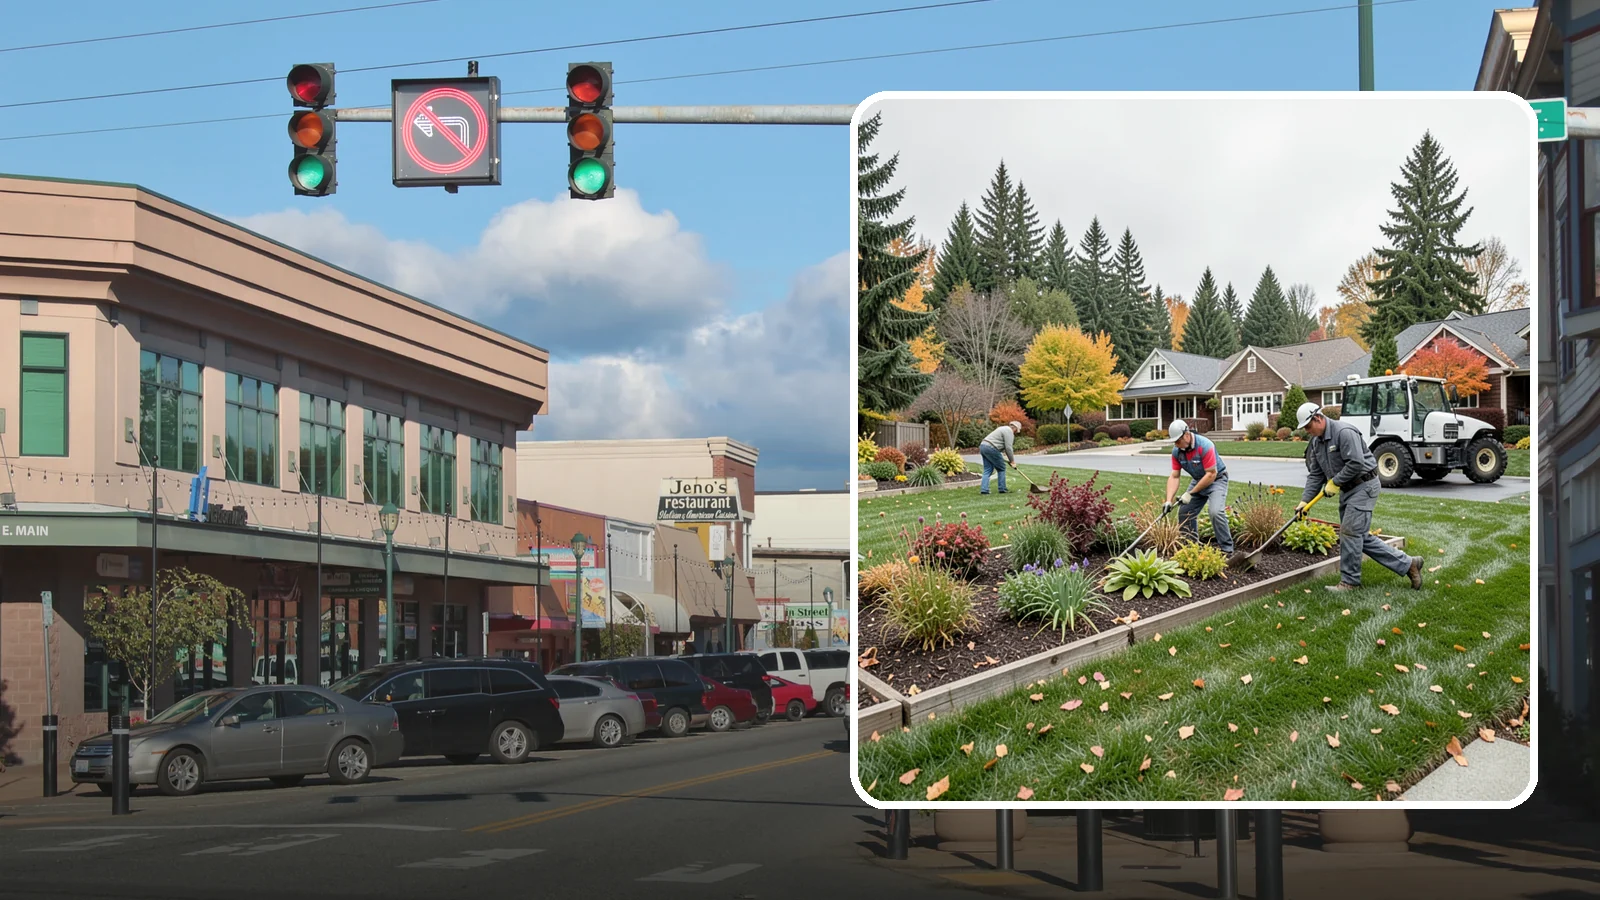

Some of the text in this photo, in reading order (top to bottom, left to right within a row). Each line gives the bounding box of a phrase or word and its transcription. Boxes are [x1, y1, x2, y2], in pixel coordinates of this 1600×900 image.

[670, 480, 727, 494] Jeno's
[665, 496, 731, 509] restaurant
[658, 510, 681, 519] Italian
[686, 510, 714, 519] American
[715, 509, 737, 519] Cuisine
[2, 525, 49, 536] E. MAIN
[797, 607, 828, 617] Street
